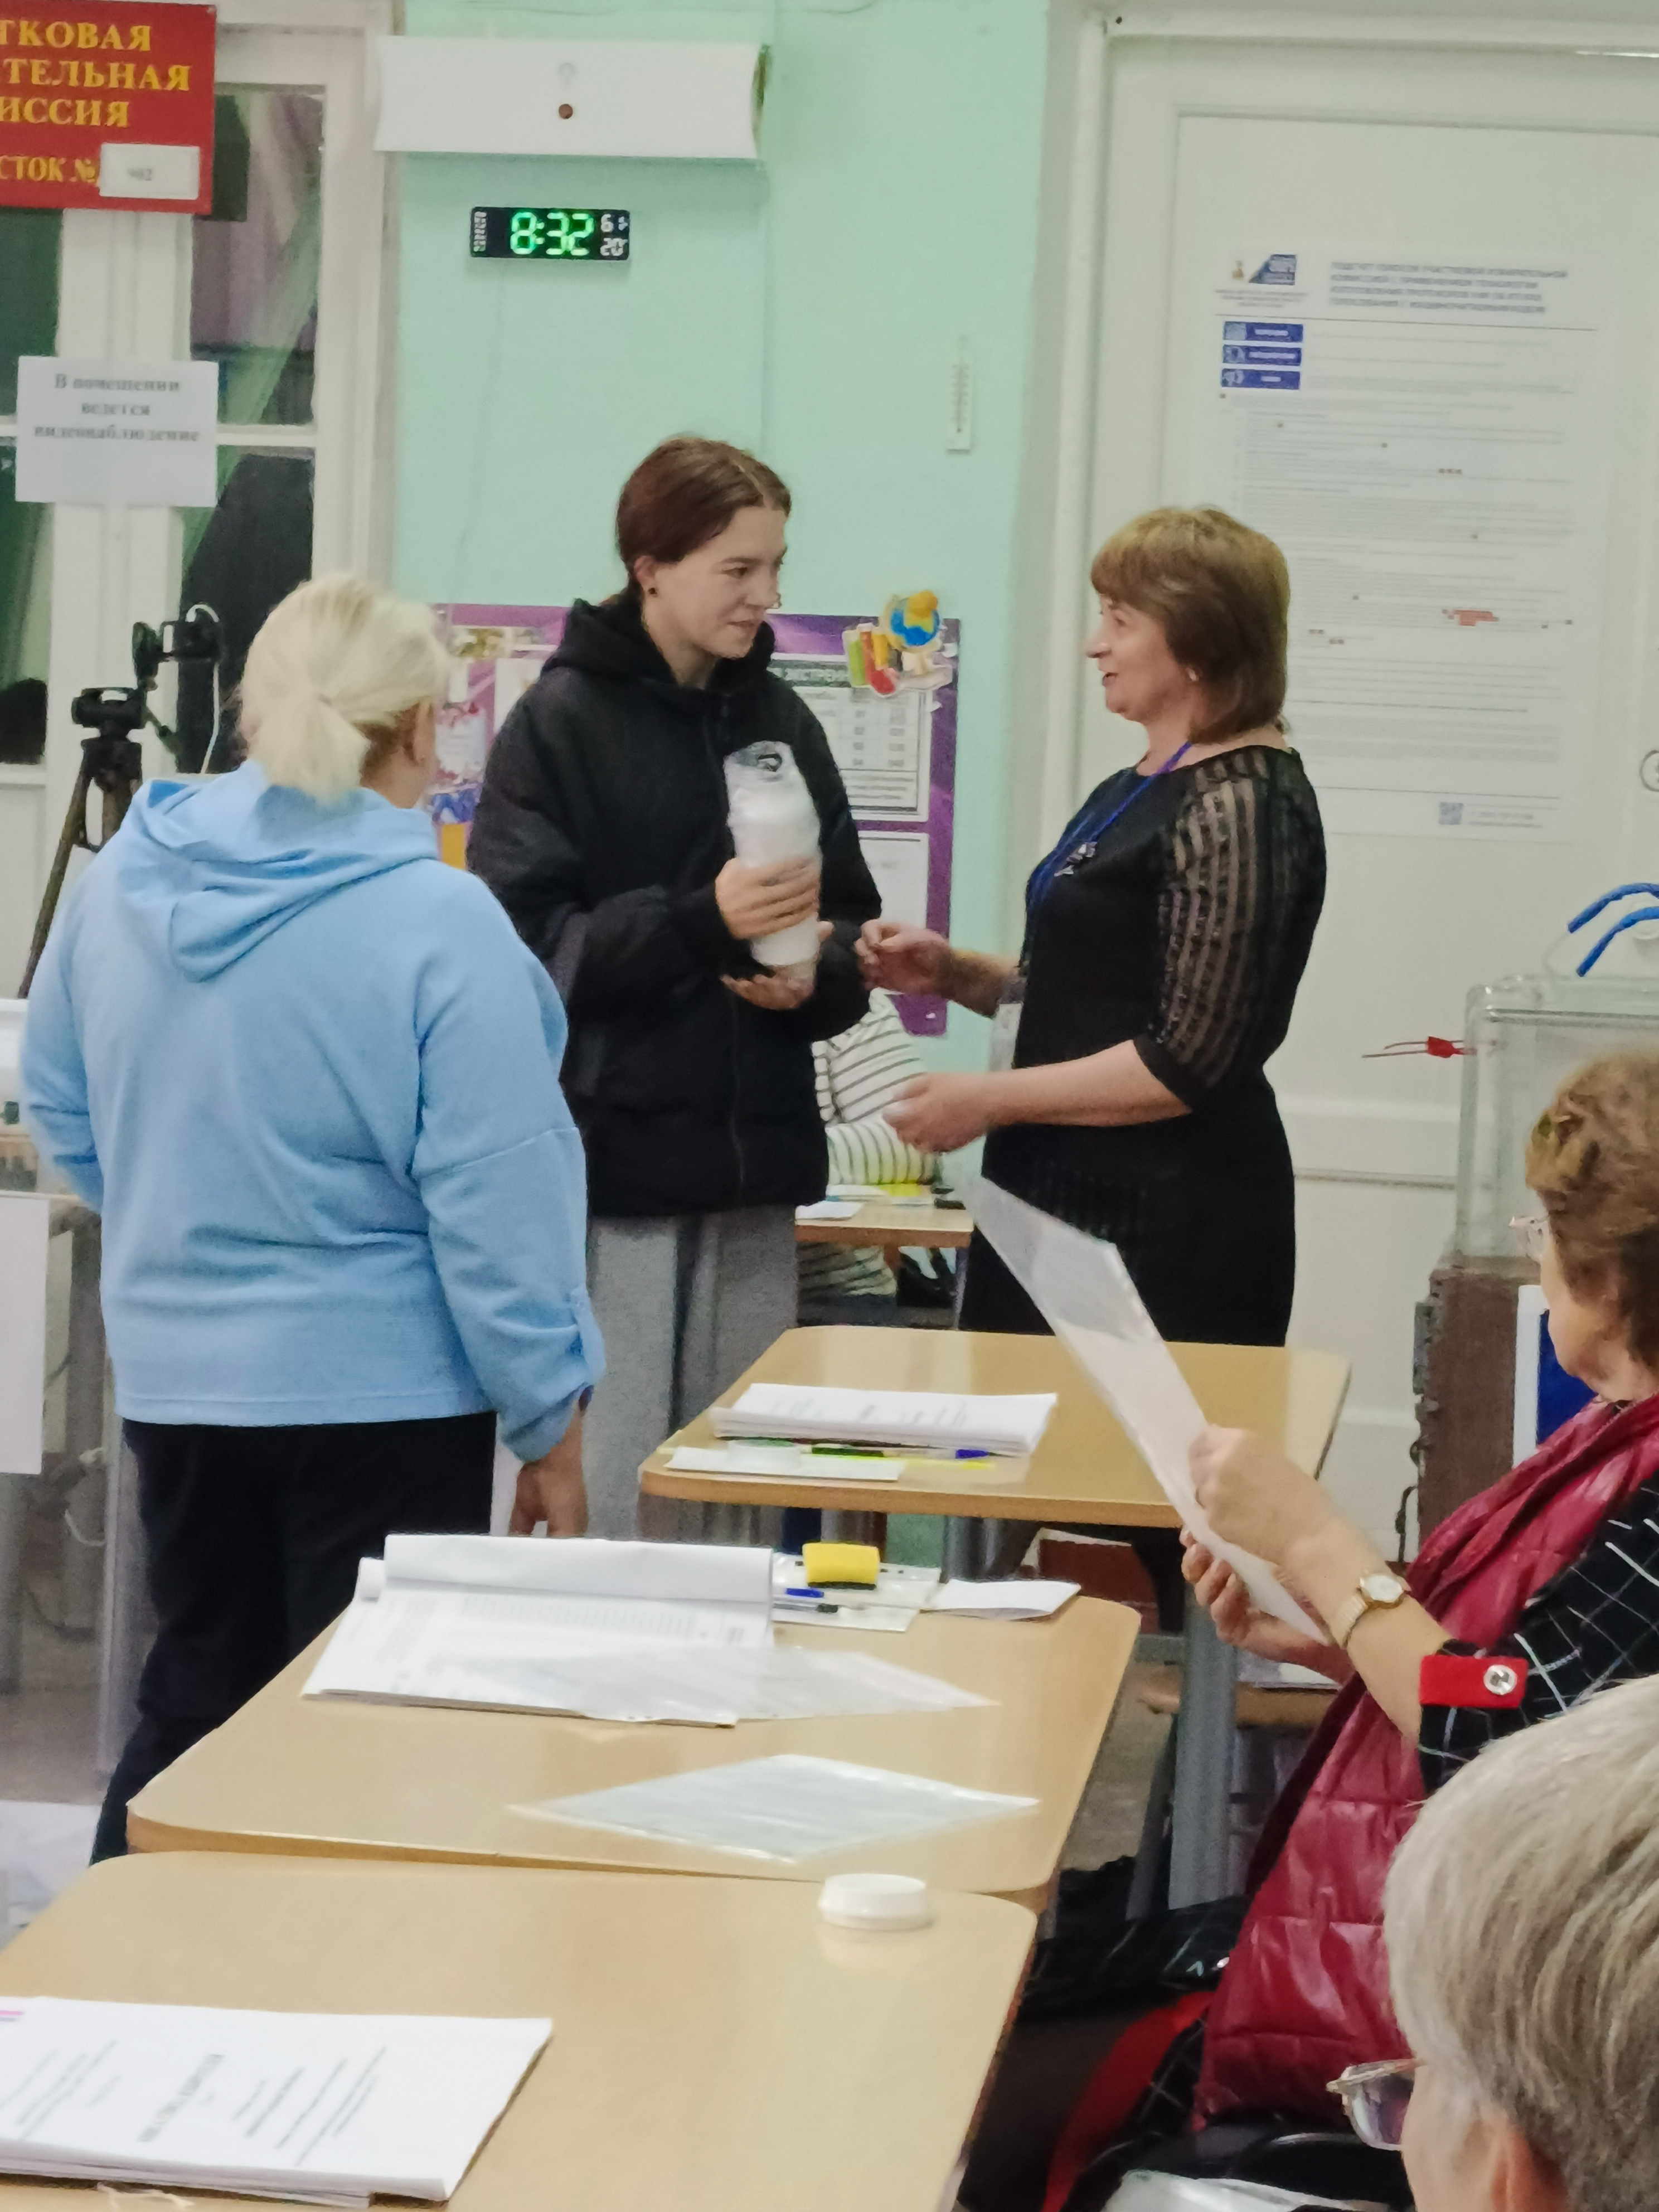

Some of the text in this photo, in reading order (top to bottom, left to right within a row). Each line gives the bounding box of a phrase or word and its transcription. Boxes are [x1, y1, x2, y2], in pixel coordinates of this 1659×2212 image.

[0, 18, 151, 51] ТКОВАЯ
[3, 58, 192, 91] ТЕЛЬНАЯ
[0, 96, 129, 128] ИССИЯ
[510, 211, 594, 255] 8:32
[55, 373, 67, 389] В
